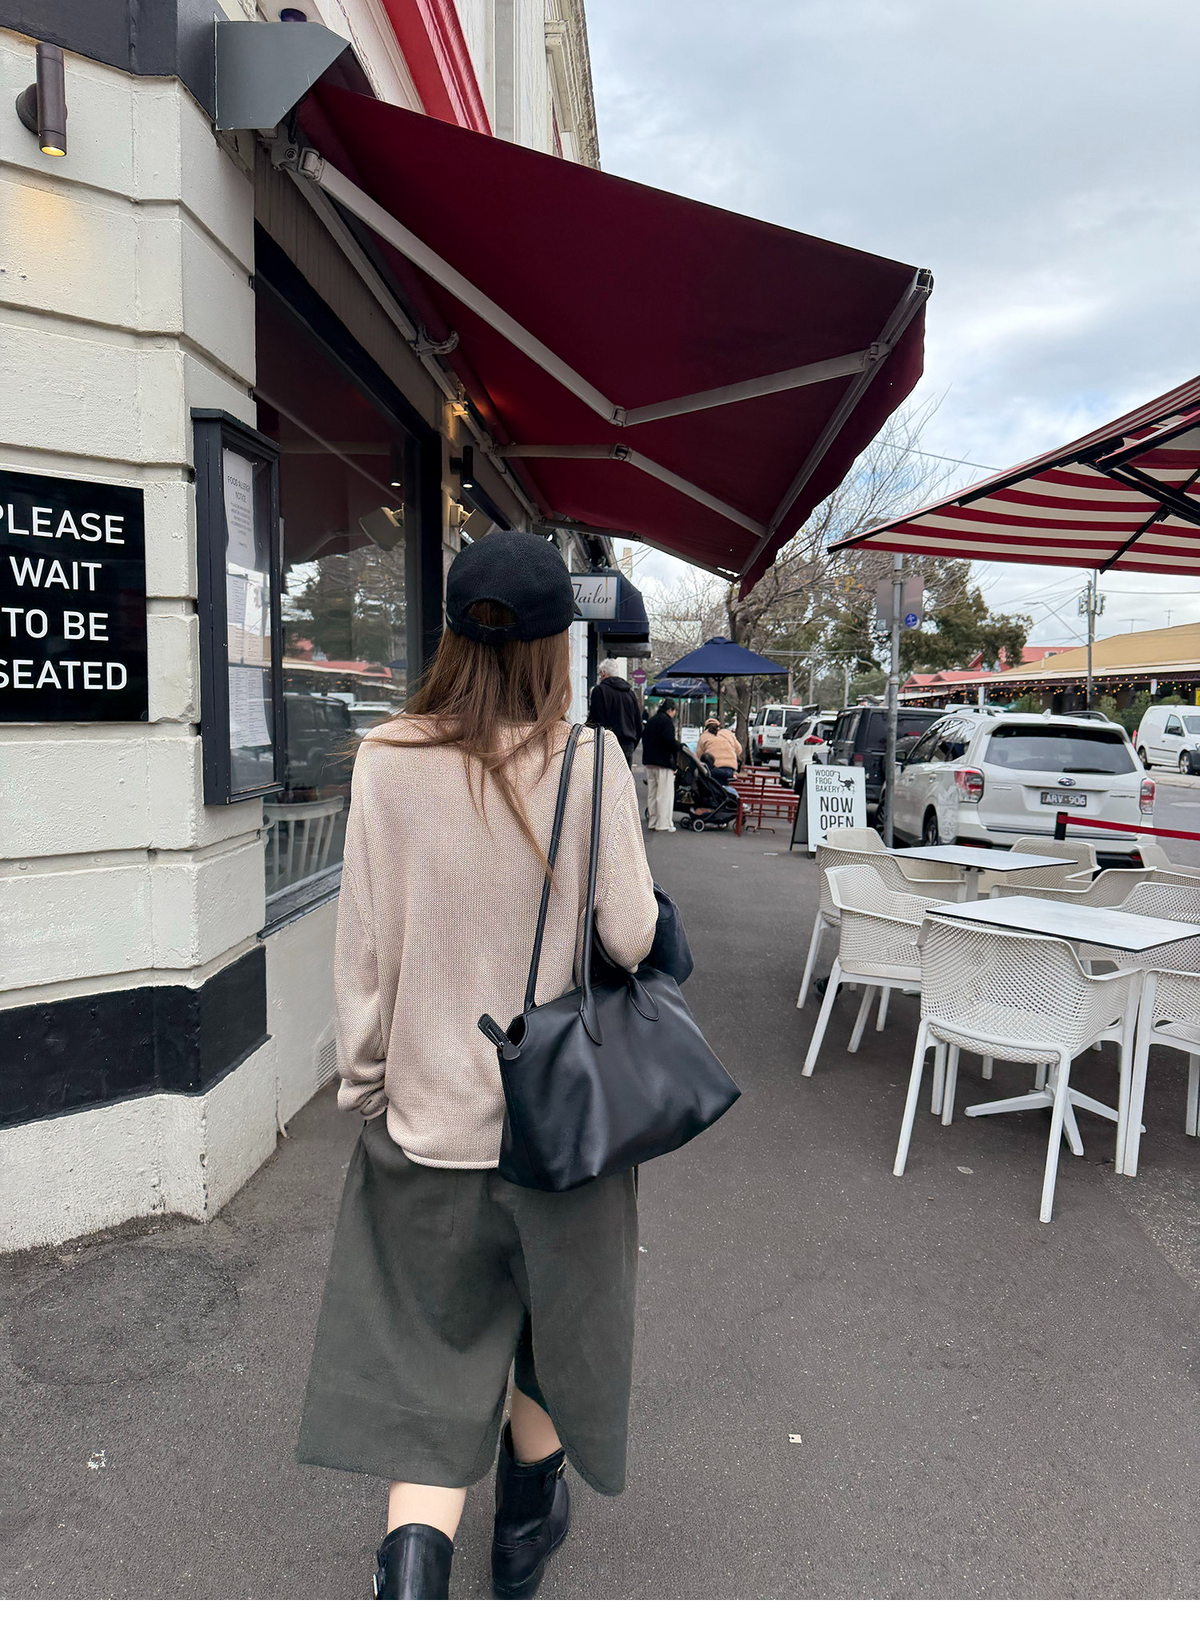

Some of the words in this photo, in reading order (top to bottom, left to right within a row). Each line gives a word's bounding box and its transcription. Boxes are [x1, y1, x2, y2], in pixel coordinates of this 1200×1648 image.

[0, 504, 125, 544] LEASE
[9, 556, 102, 591] WAIT
[571, 583, 612, 604] Tailor
[1, 607, 48, 639] TO
[63, 610, 109, 642] BE
[815, 769, 835, 777] WOOD
[815, 777, 833, 785] FROG
[815, 785, 840, 793] BAKERY
[820, 796, 854, 813] NOW
[820, 814, 854, 830] OPEN
